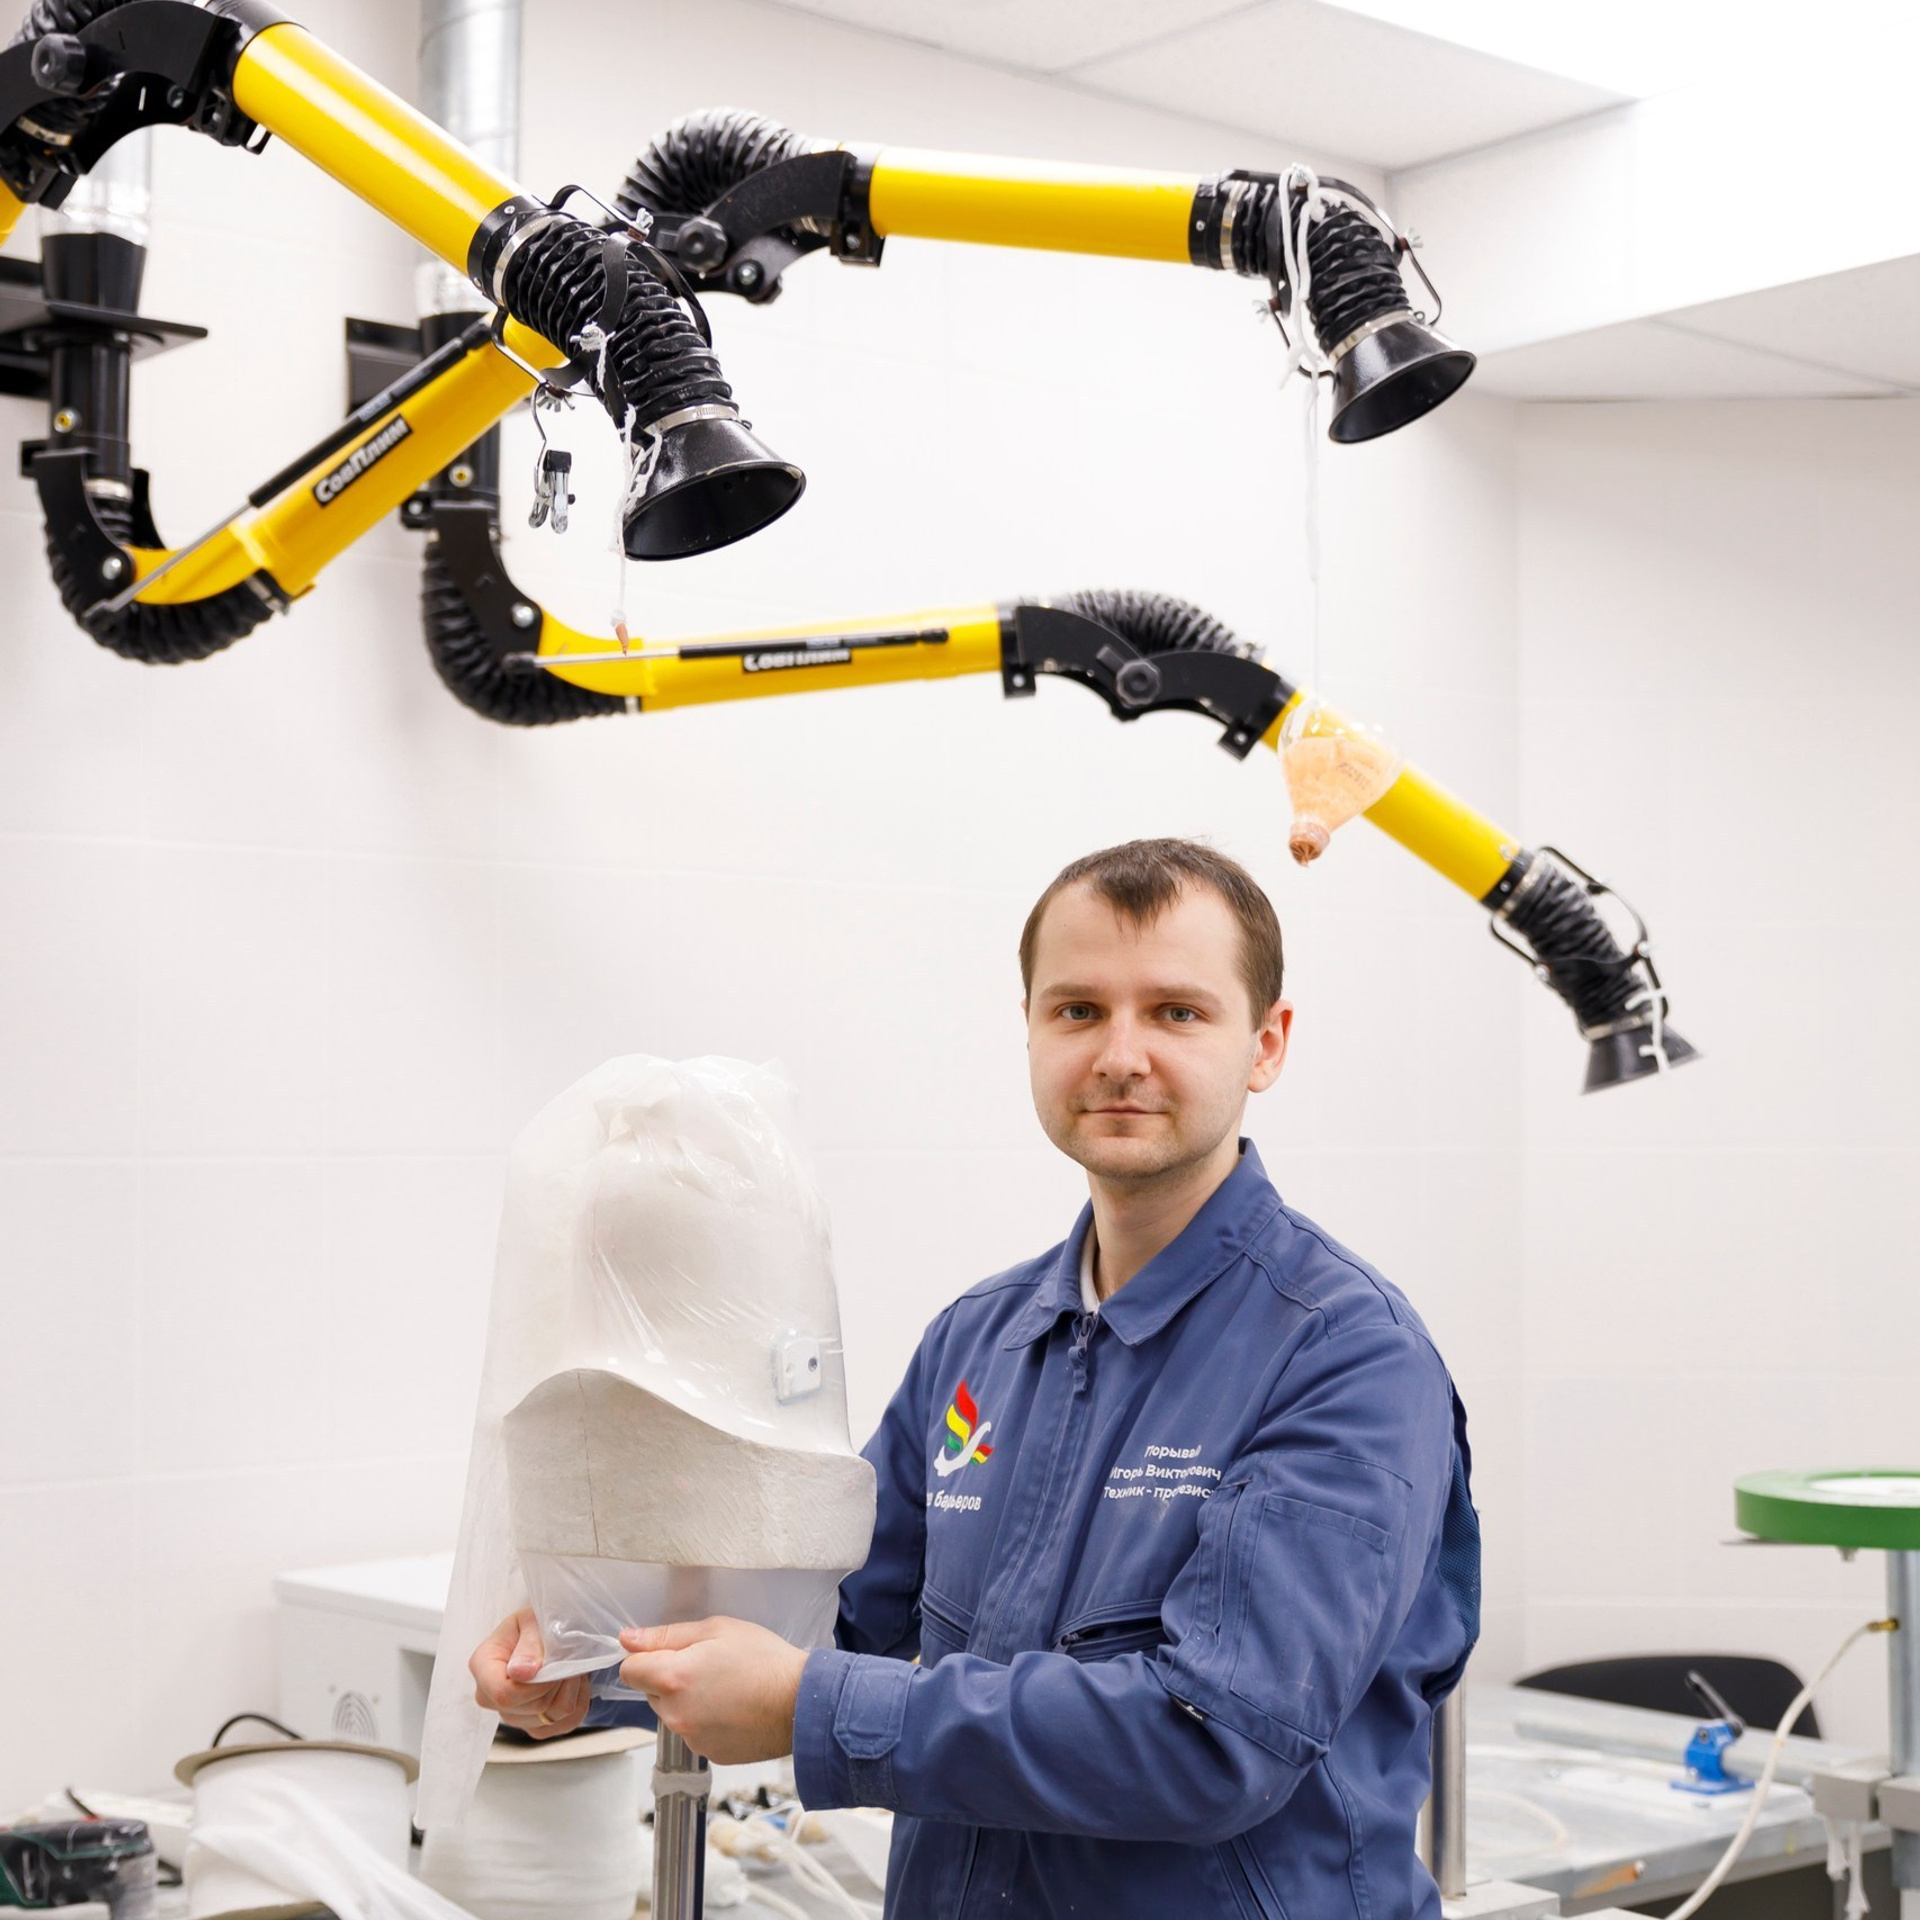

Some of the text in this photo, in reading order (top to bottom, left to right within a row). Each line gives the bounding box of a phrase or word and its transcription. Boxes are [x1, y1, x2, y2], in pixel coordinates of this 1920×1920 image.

[1109, 1463, 1222, 1481] Игорь Виктоович
[1103, 1485, 1146, 1499] Техник
[1153, 1484, 1215, 1501] проезис
